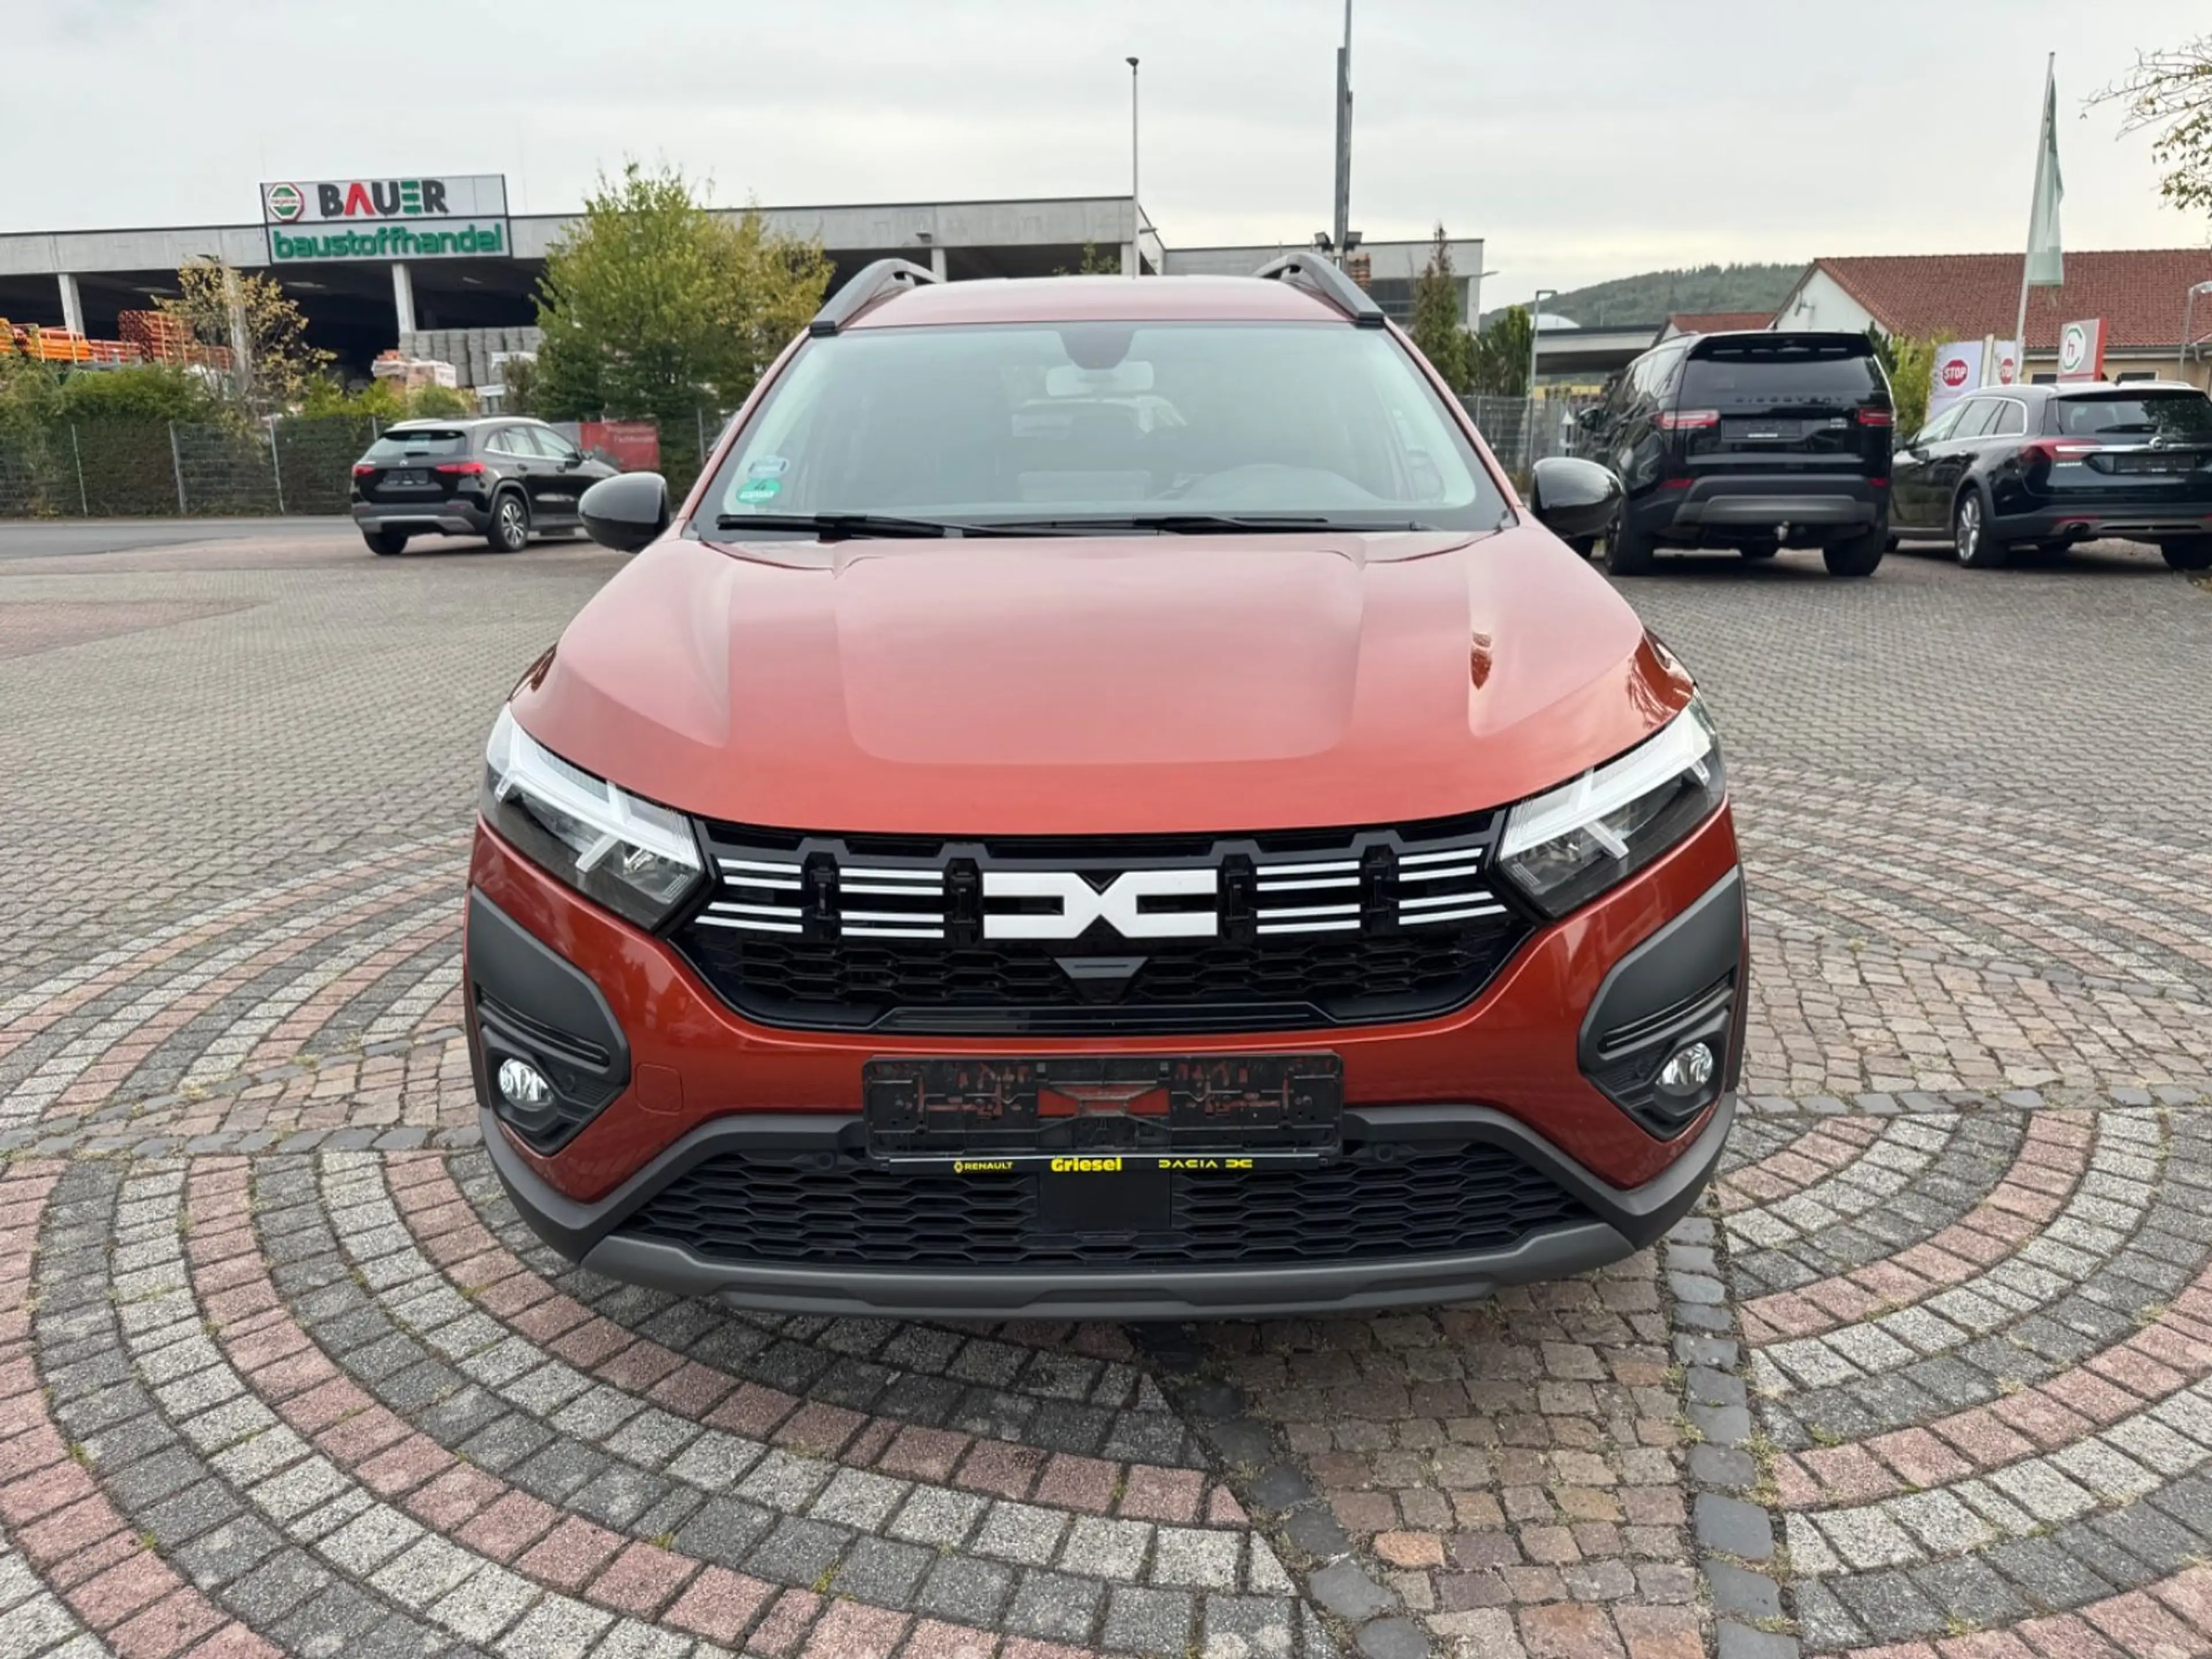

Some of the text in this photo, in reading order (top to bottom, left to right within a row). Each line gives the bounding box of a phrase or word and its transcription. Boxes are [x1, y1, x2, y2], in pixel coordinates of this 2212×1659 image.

[318, 180, 449, 217] BAUER
[272, 223, 502, 257] baustoffhandel
[1944, 366, 1967, 380] STOP
[964, 1161, 1013, 1171] RENAULT
[1051, 1156, 1123, 1173] Griesel
[1157, 1158, 1219, 1169] DACIA
